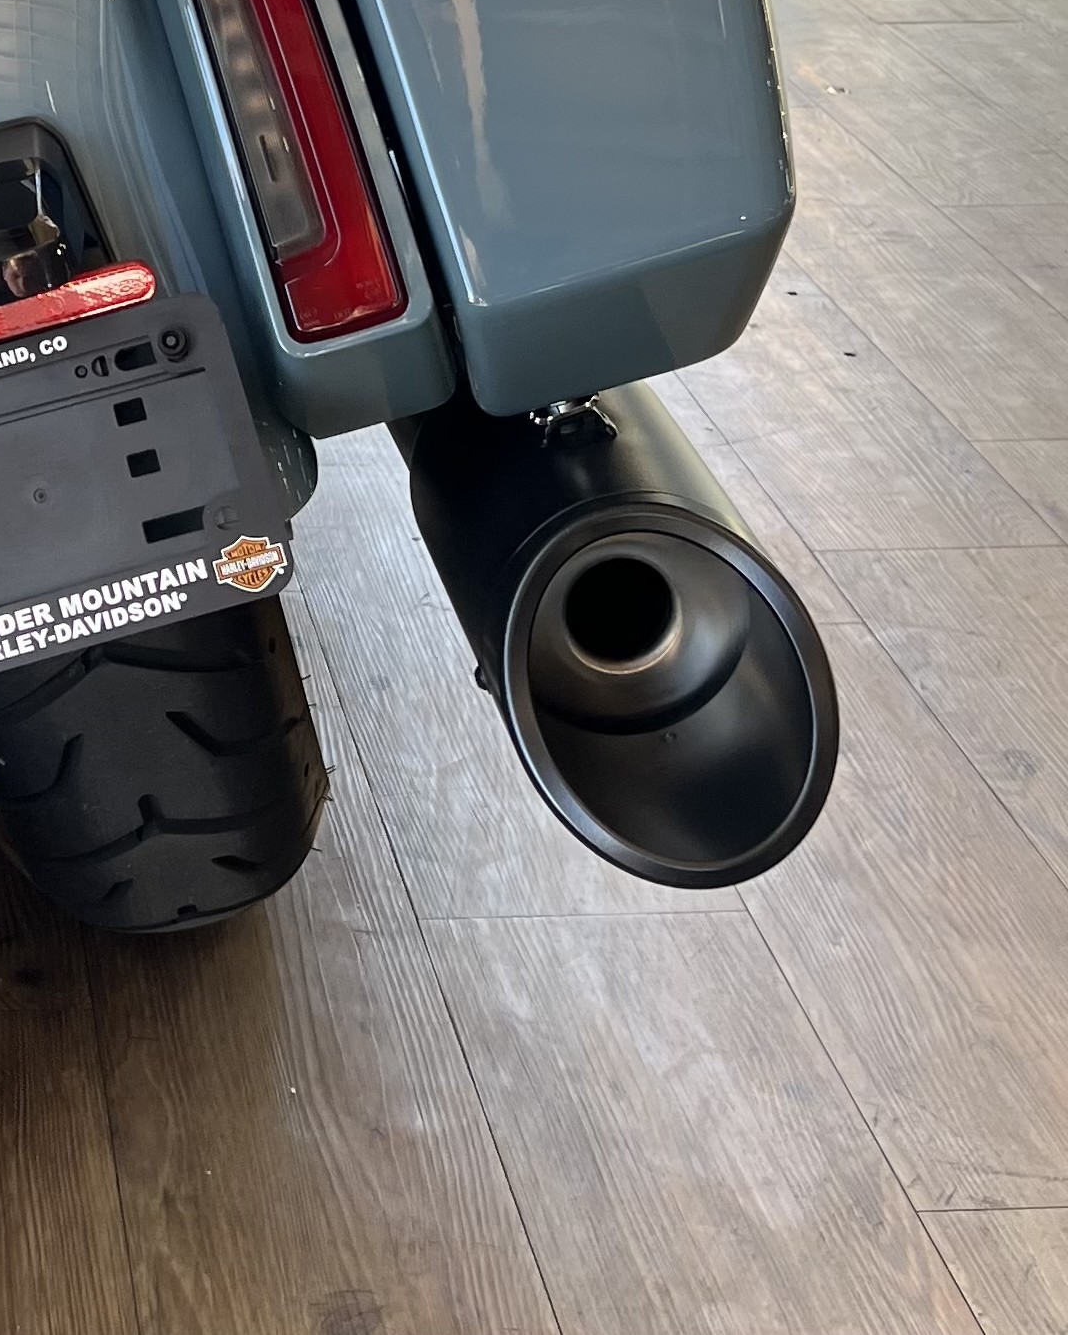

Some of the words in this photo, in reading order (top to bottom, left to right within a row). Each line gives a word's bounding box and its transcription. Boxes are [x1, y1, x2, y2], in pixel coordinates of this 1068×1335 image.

[39, 335, 68, 355] CO
[231, 543, 262, 558] MOTOR
[220, 549, 280, 575] HARLEY-DAVIDSON
[58, 558, 209, 615] MOUNTAIN
[238, 568, 269, 585] CYCLES
